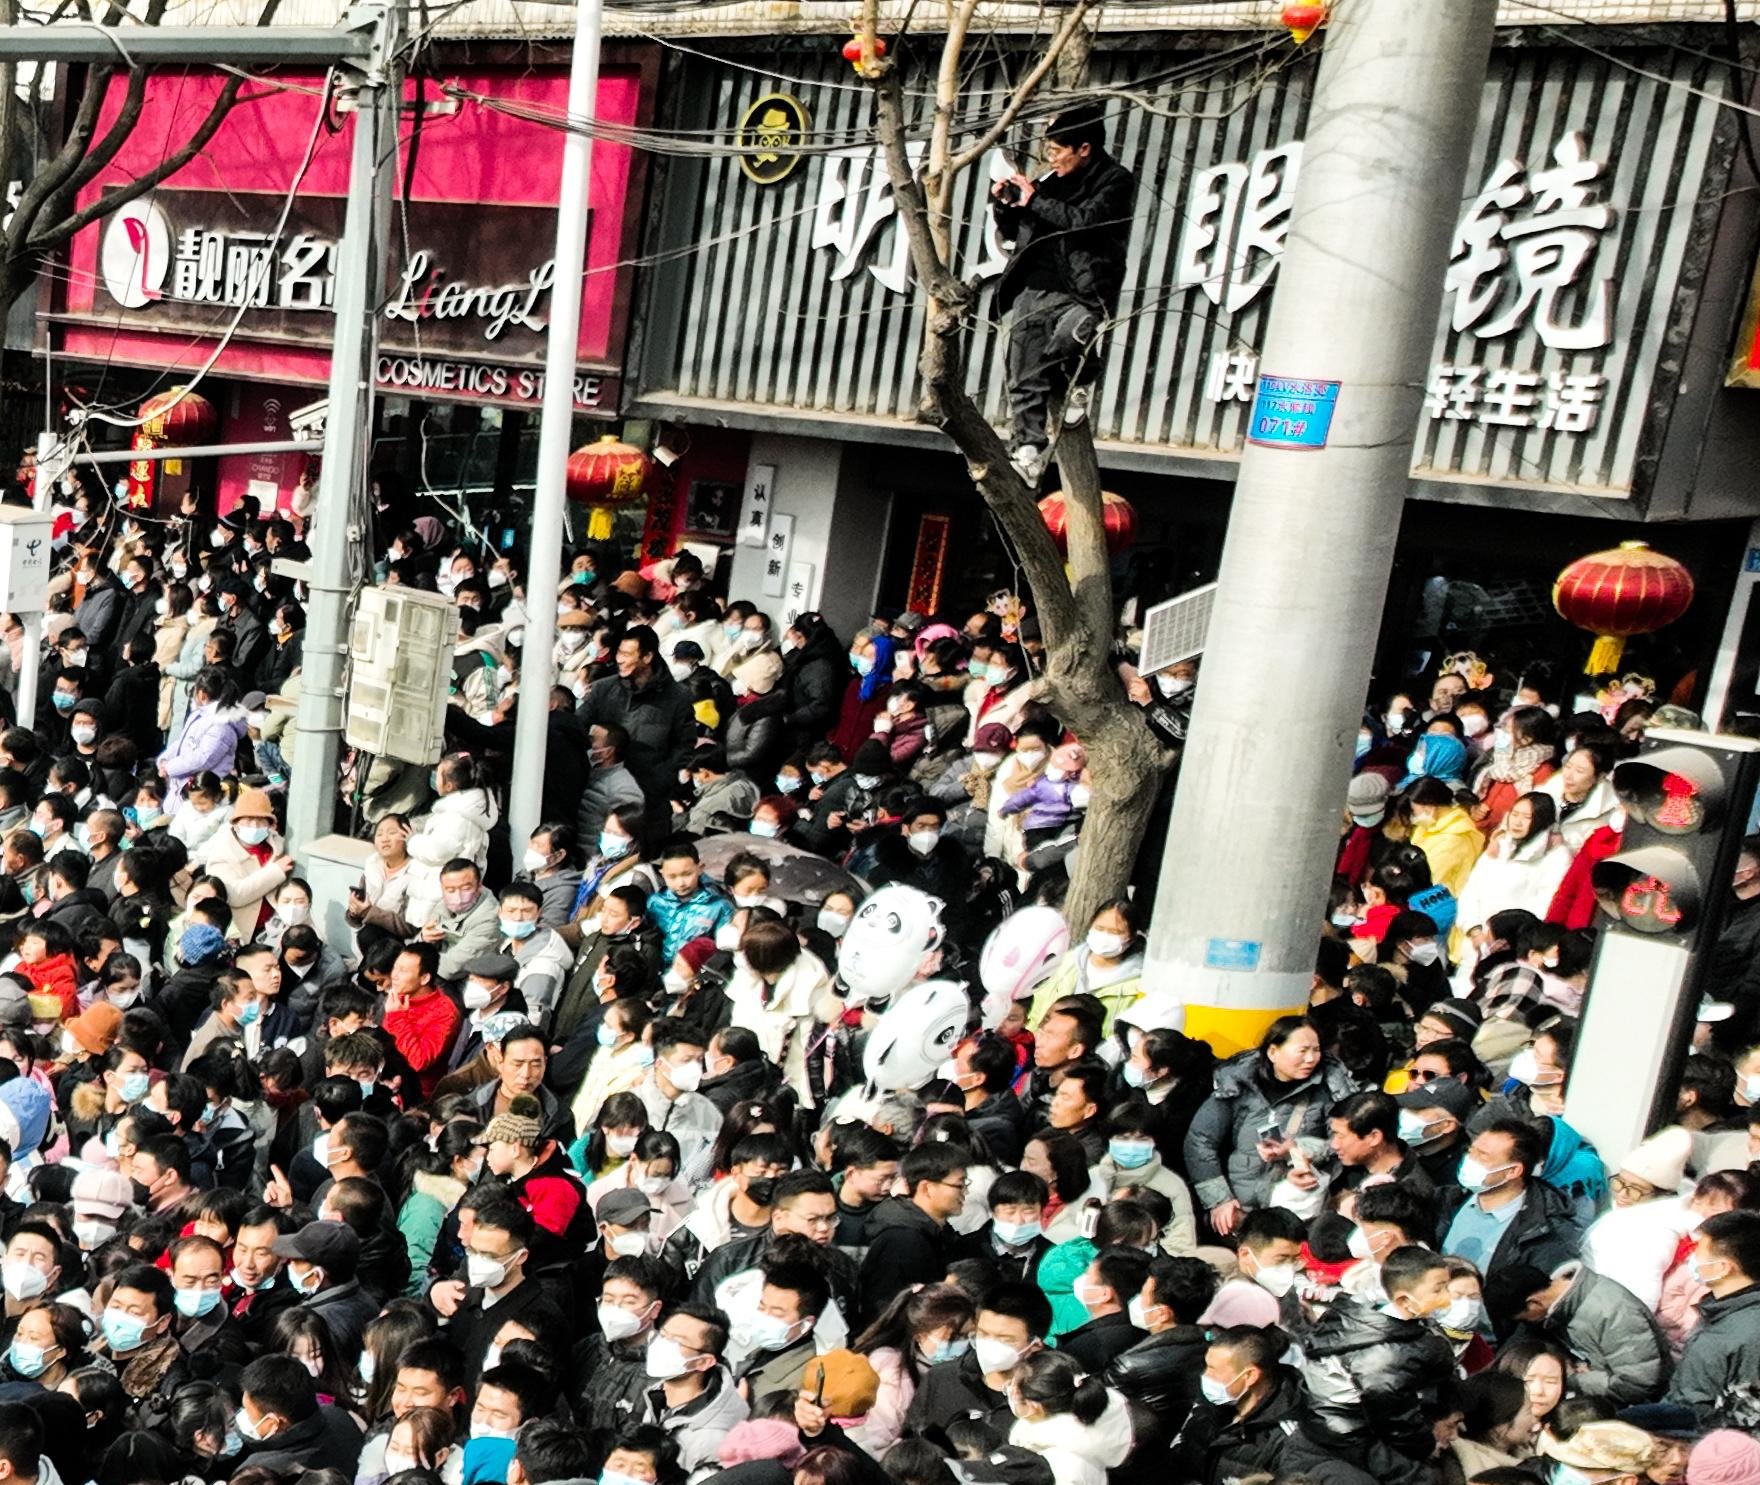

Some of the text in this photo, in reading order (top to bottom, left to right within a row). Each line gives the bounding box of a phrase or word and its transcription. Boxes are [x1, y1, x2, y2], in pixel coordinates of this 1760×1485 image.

[812, 130, 1613, 349] 明眼镜
[174, 230, 342, 309] 靓丽名
[376, 357, 600, 406] COSMETICS STRE
[1425, 364, 1605, 432] 轻生活
[750, 484, 766, 528] 认真
[768, 534, 785, 577] 创新
